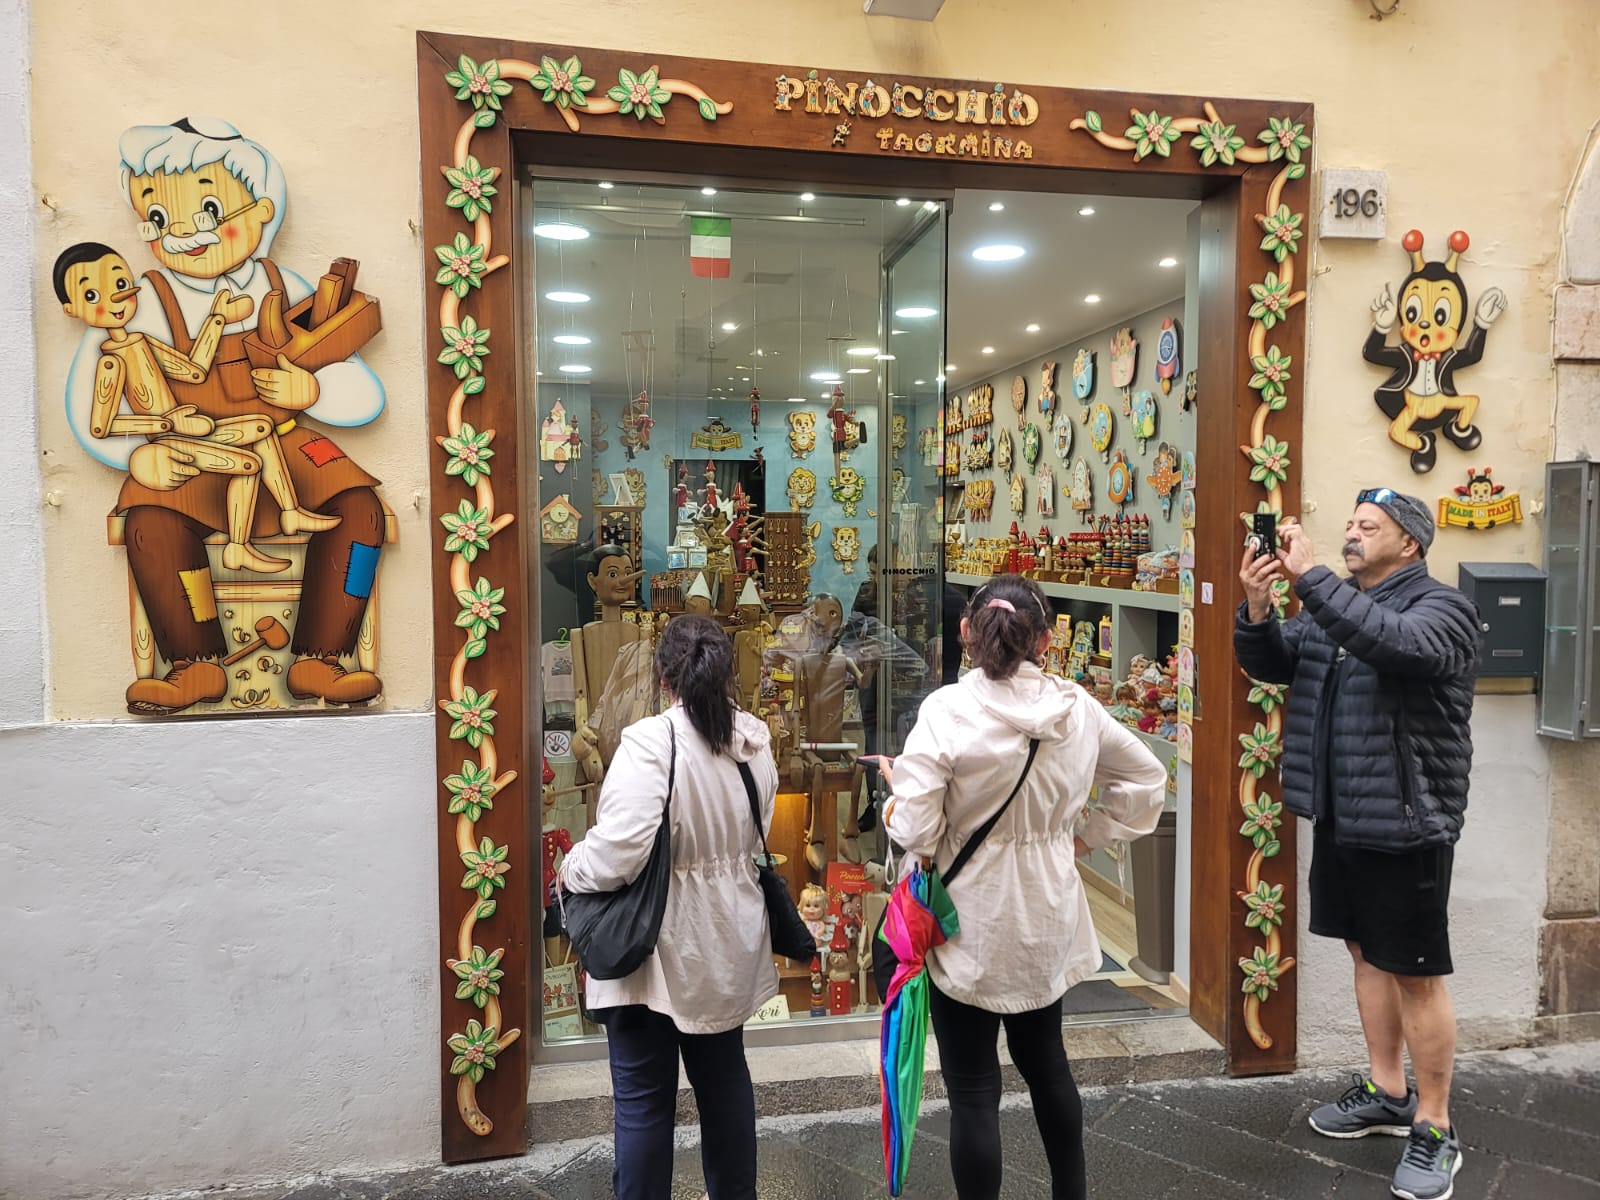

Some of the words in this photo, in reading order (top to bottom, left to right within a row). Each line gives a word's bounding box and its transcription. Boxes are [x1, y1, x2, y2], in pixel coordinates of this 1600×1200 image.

[875, 127, 1034, 160] TAORMINA
[1332, 188, 1379, 218] 196
[1449, 505, 1473, 518] MADE
[1475, 508, 1485, 518] IN
[1487, 503, 1511, 518] ITALY
[882, 567, 936, 576] PINOCCHIO
